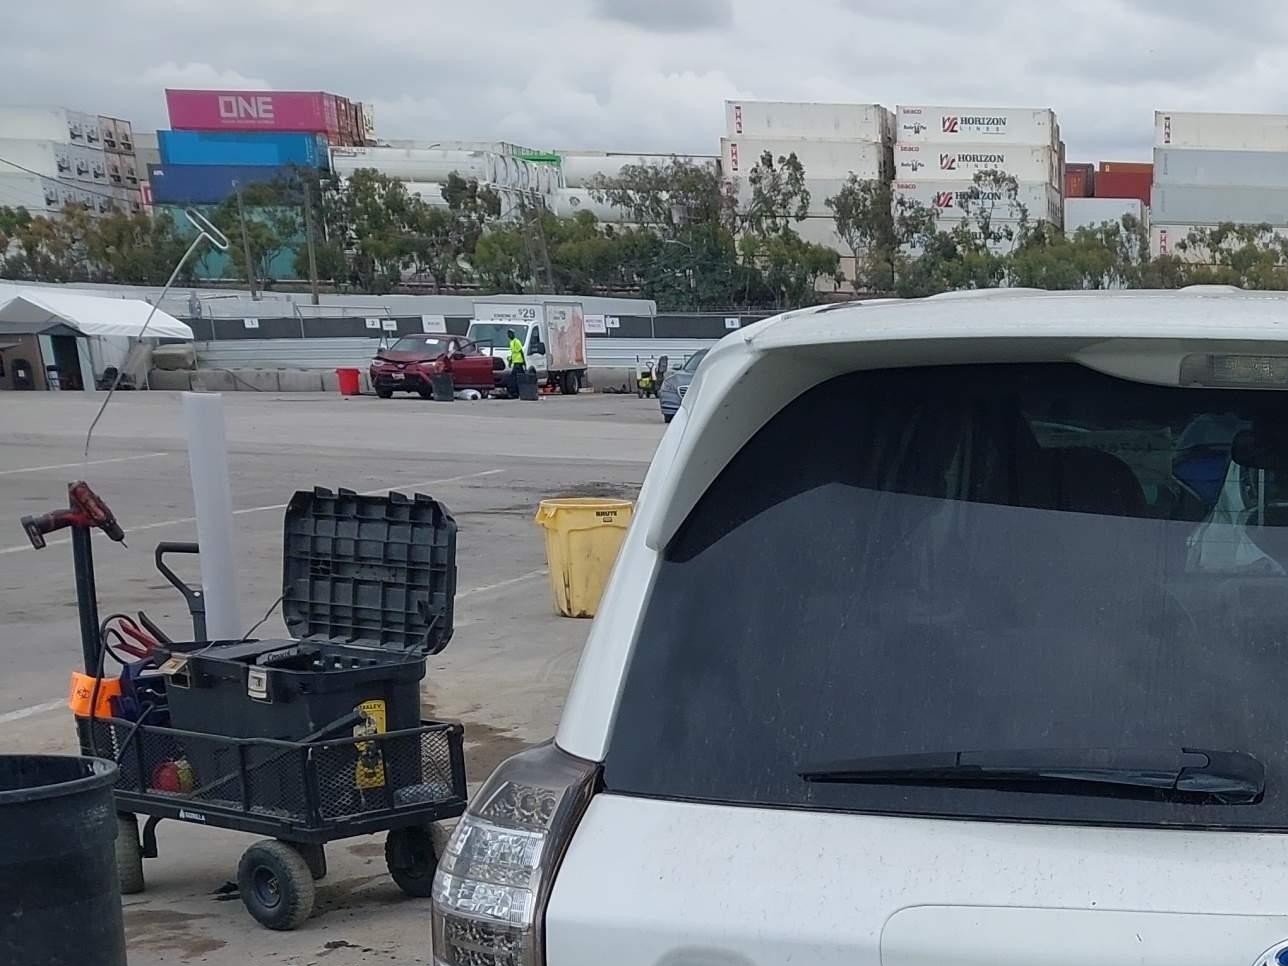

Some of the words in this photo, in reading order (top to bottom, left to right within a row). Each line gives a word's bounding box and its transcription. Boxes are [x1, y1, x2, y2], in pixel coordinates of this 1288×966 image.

[218, 96, 274, 118] ONE
[960, 116, 1007, 126] HORIZON
[957, 154, 1005, 163] HORIZON
